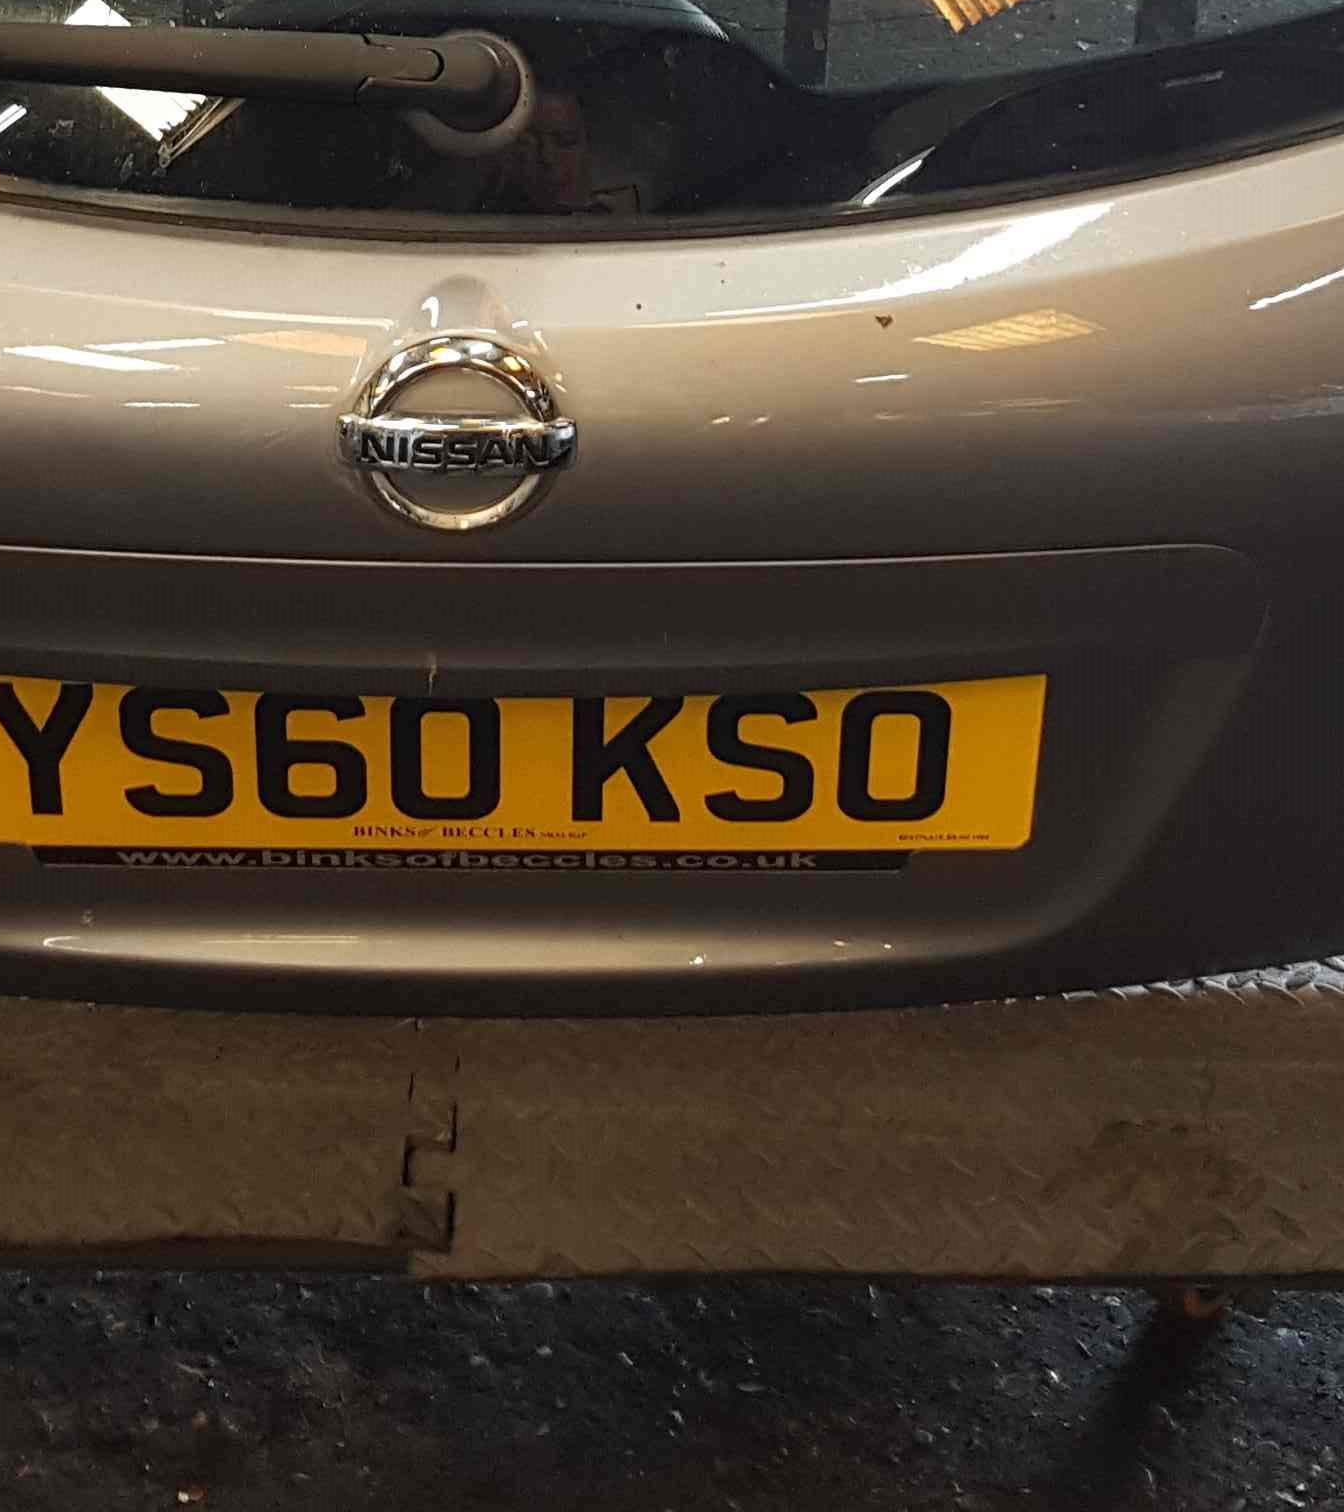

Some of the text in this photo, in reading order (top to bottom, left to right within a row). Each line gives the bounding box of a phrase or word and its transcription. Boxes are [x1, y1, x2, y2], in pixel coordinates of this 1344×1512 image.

[356, 432, 554, 468] NISSAN
[571, 690, 952, 823] KSO
[352, 825, 417, 839] BINKS
[442, 826, 537, 839] BECCLES
[116, 849, 817, 869] www.binksofbeccles.co.uk
